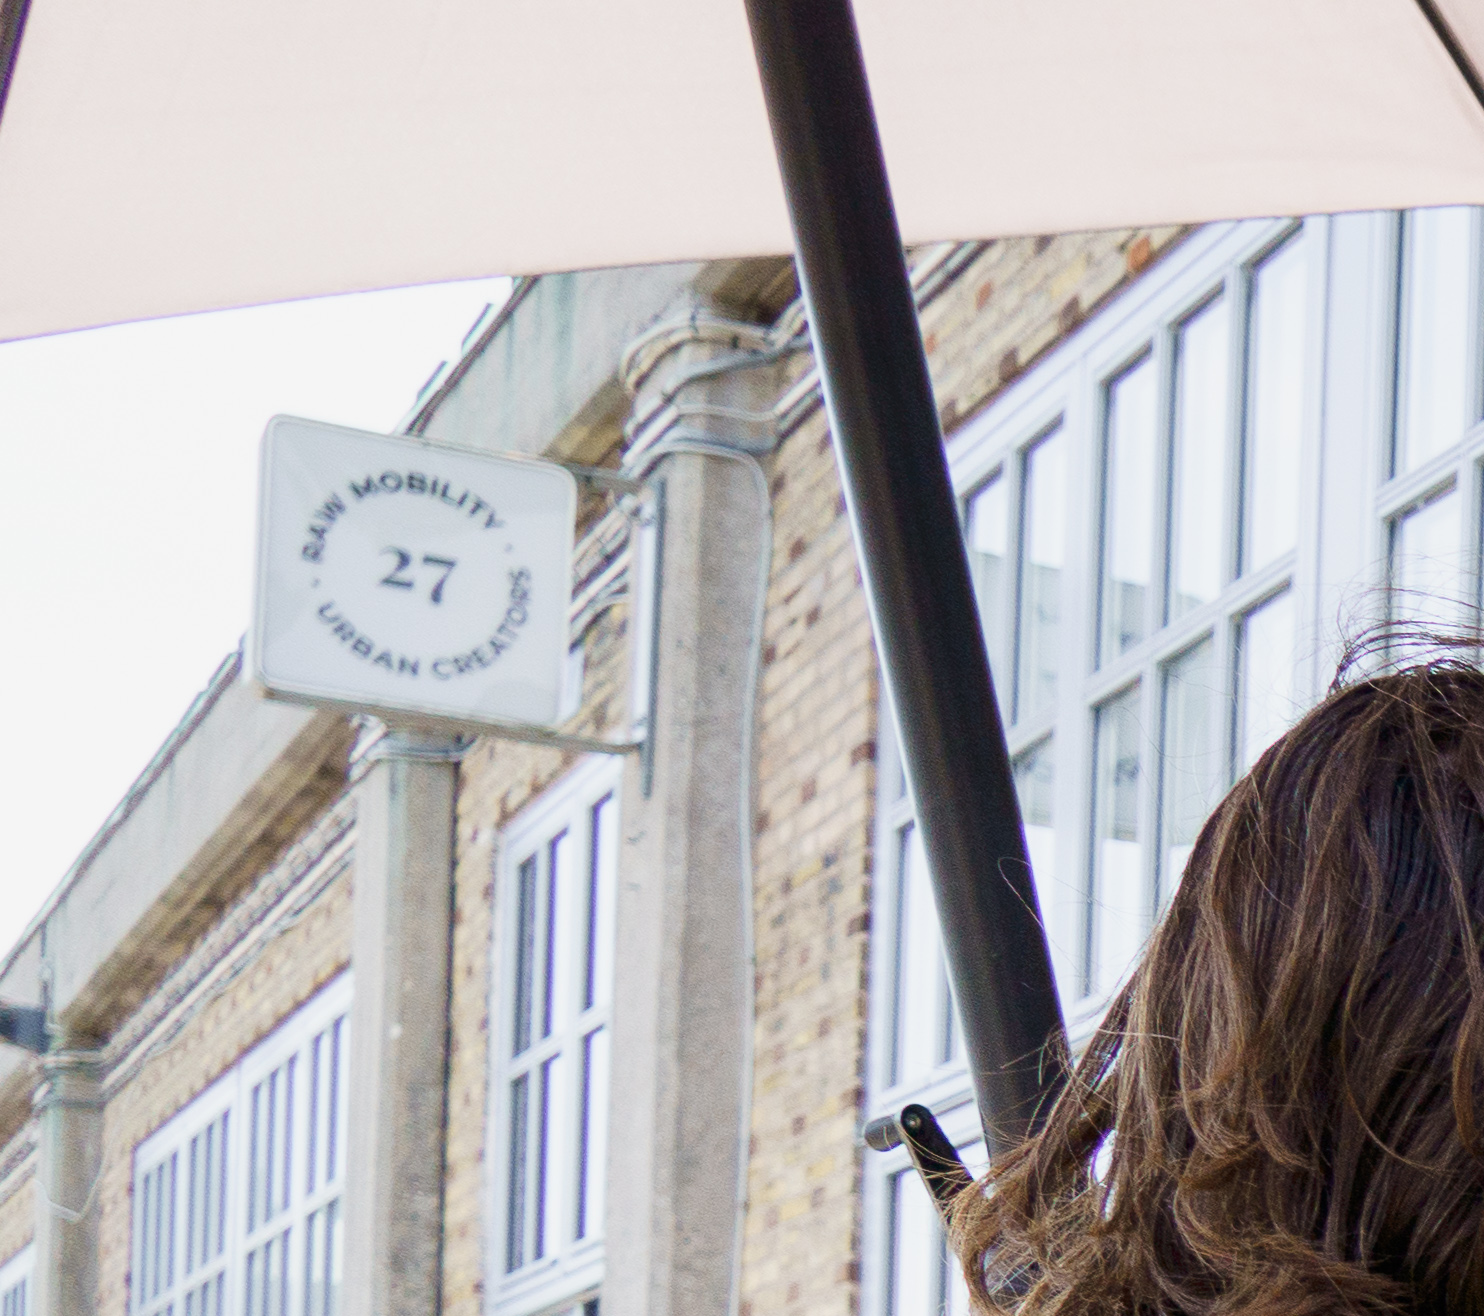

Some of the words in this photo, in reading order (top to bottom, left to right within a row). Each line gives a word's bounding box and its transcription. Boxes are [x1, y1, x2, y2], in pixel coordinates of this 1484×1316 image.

[302, 493, 346, 563] RAW
[348, 470, 506, 530] MOBILITY
[380, 545, 457, 605] 27
[317, 599, 421, 677] URBAN
[431, 566, 532, 681] CREATORS
